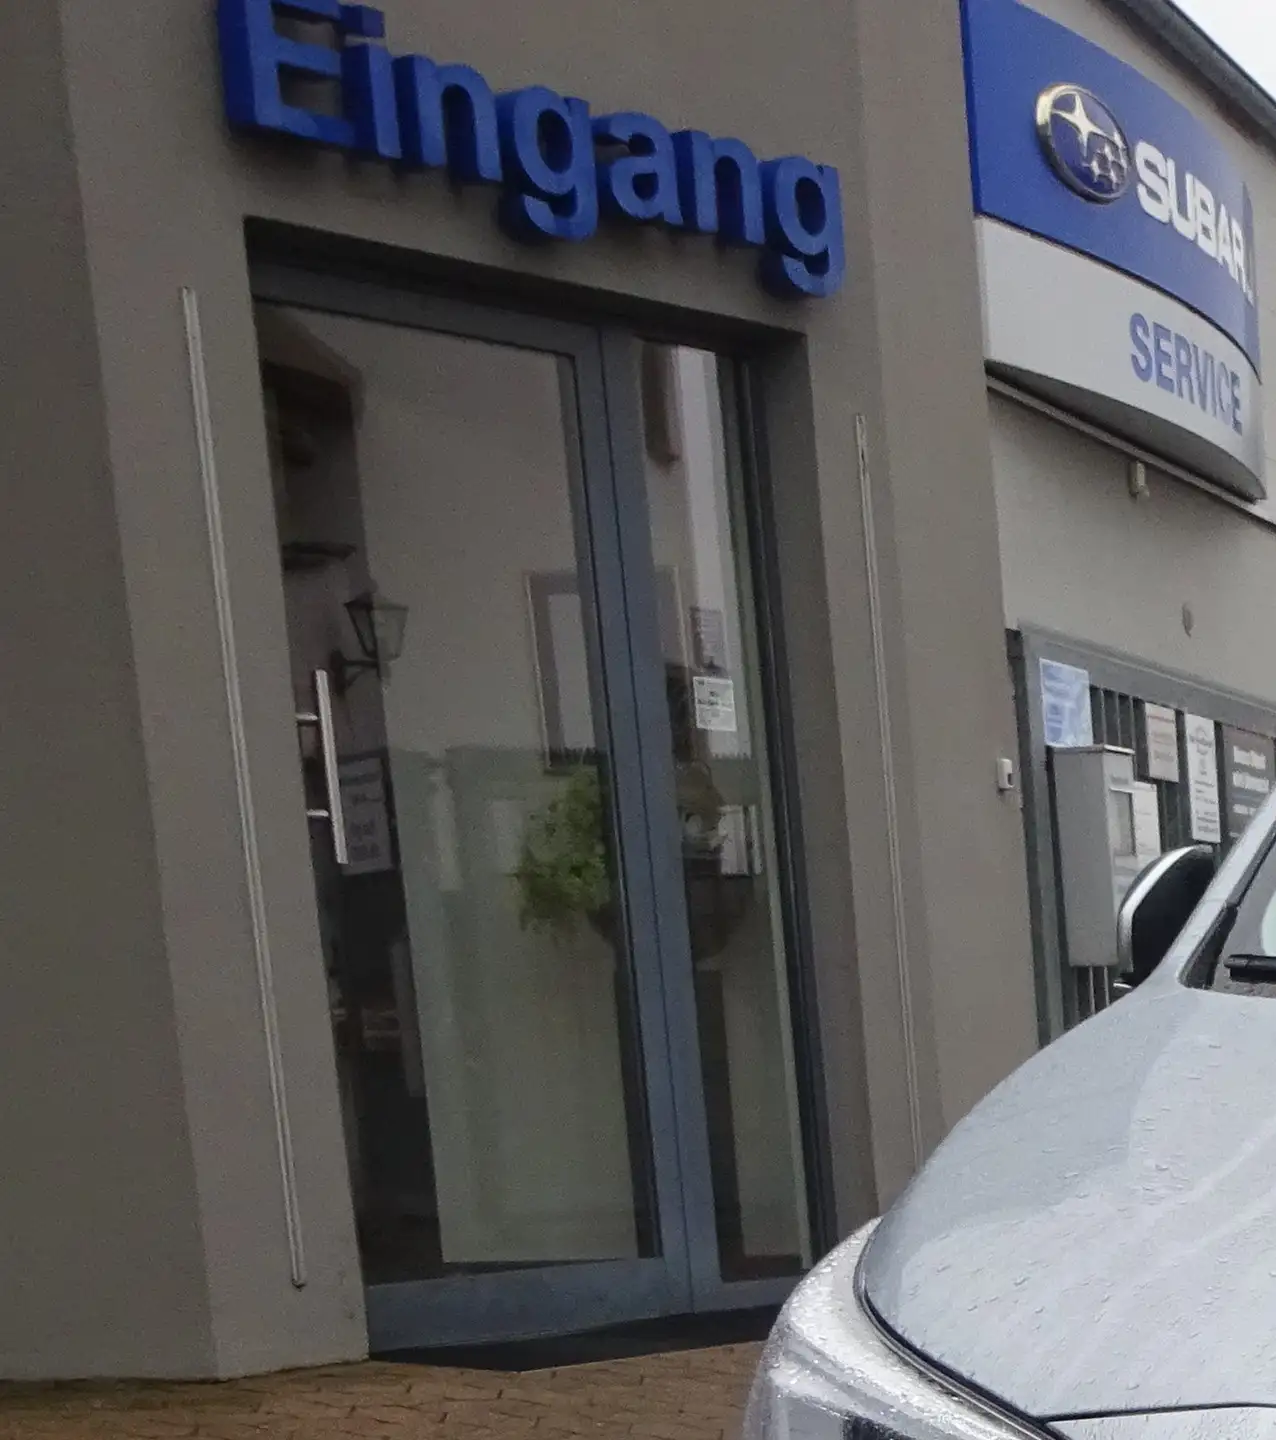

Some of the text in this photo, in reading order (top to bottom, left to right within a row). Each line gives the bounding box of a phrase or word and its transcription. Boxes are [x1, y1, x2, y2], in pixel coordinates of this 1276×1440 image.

[222, 0, 846, 298] Eingang
[1134, 140, 1254, 307] SUBAR
[1129, 312, 1243, 436] SERVICE
